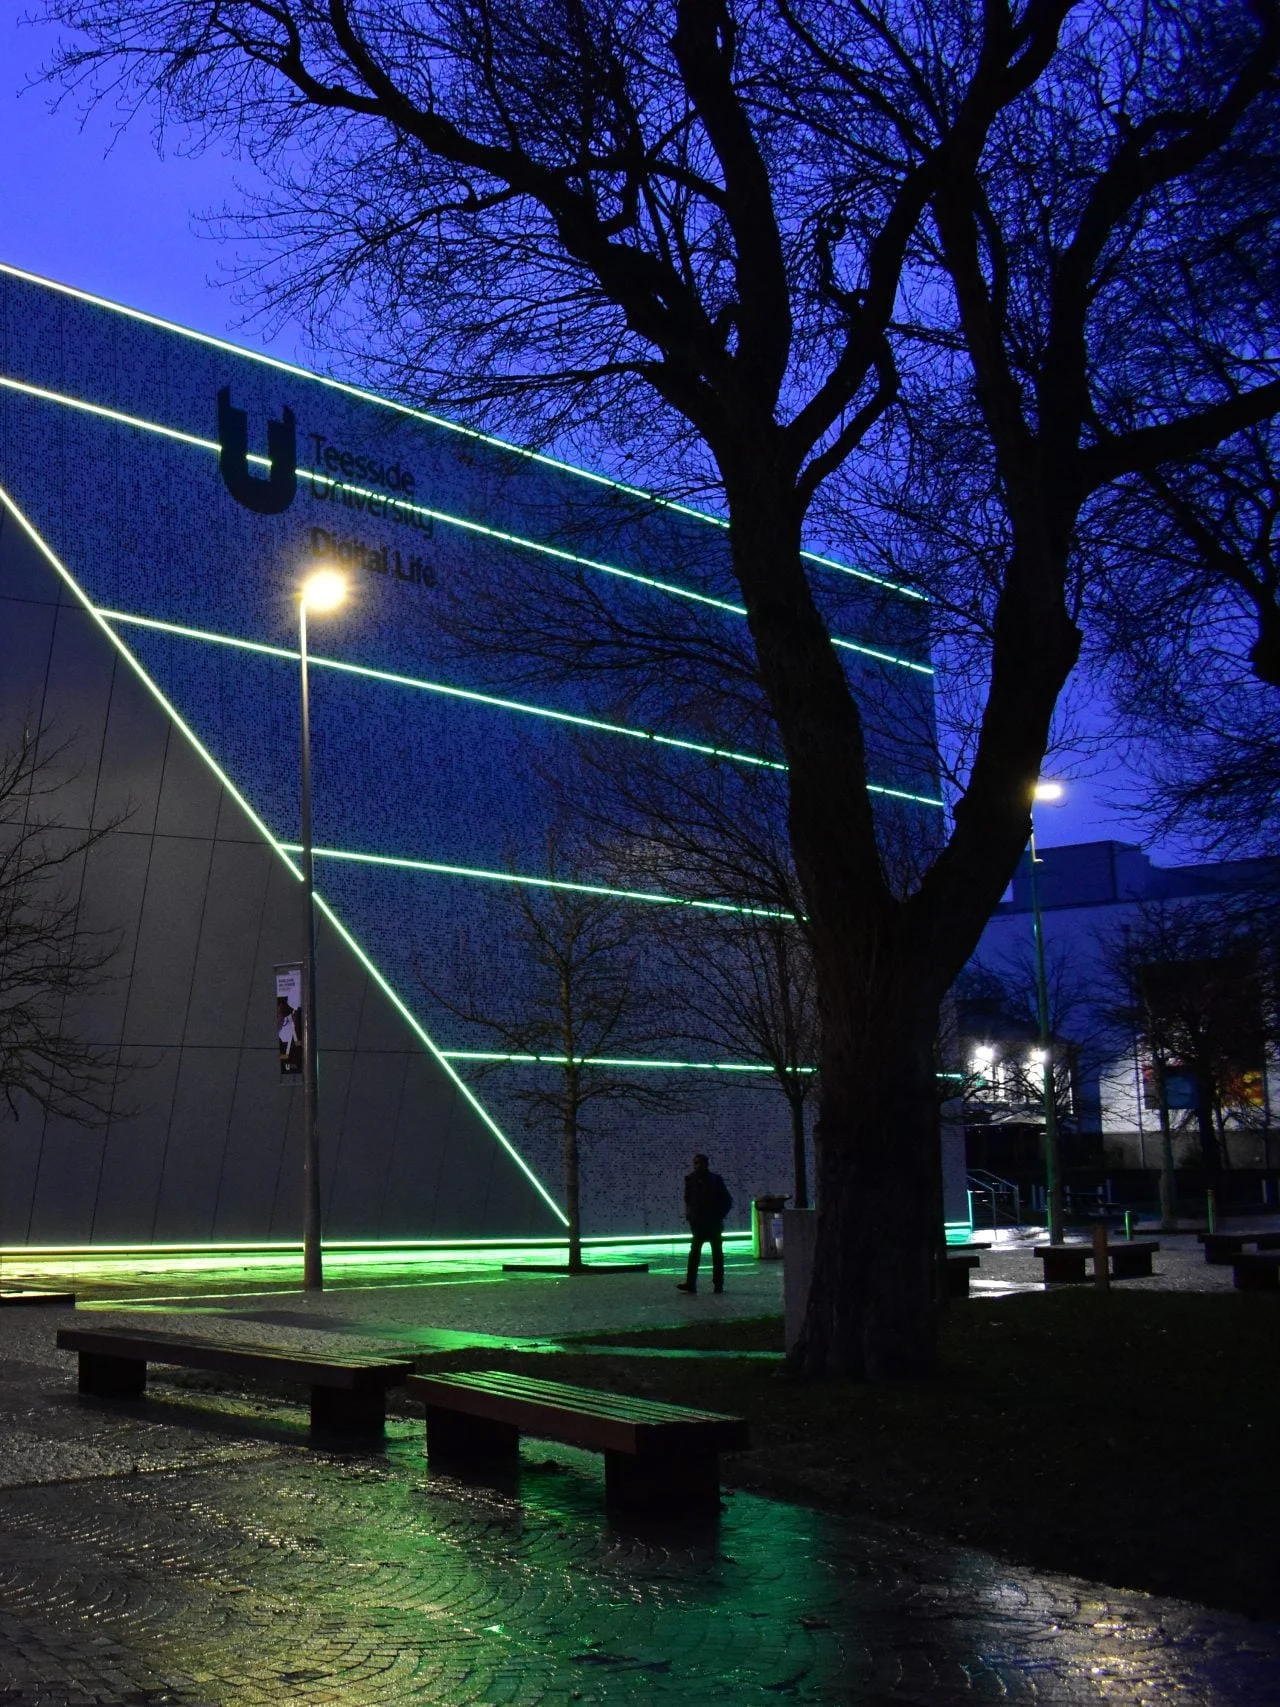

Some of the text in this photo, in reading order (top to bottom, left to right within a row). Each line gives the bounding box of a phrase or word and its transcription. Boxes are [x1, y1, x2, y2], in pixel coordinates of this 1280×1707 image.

[309, 431, 416, 497] Teesside
[310, 466, 434, 540] University
[394, 550, 437, 588] Life
